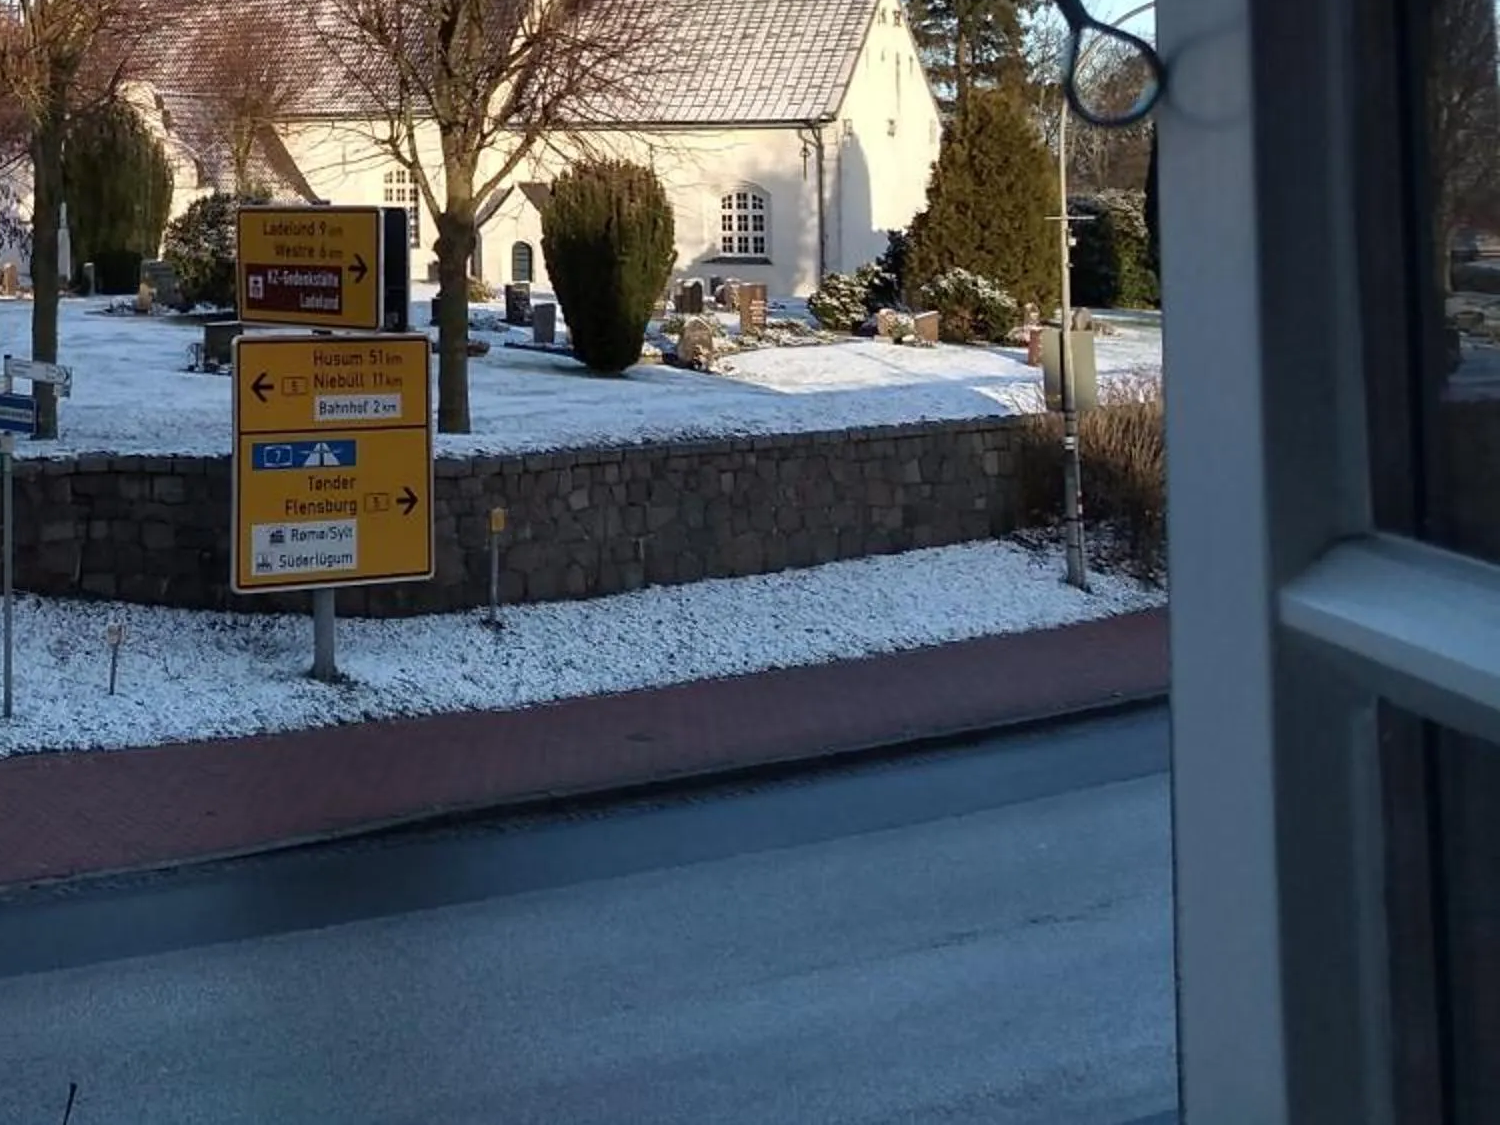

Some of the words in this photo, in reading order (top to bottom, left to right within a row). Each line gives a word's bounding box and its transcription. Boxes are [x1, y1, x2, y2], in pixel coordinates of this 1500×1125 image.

[313, 350, 363, 366] Husum
[369, 348, 383, 365] 51
[386, 352, 403, 365] km
[372, 372, 383, 386] 11
[386, 375, 403, 387] km
[319, 400, 368, 416] Bahnhof
[373, 399, 381, 413] 2
[382, 402, 397, 413] km
[274, 449, 281, 463] 7
[307, 475, 357, 491] Tønder
[284, 496, 358, 516] Flensburg
[278, 552, 353, 569] Süderlügum
